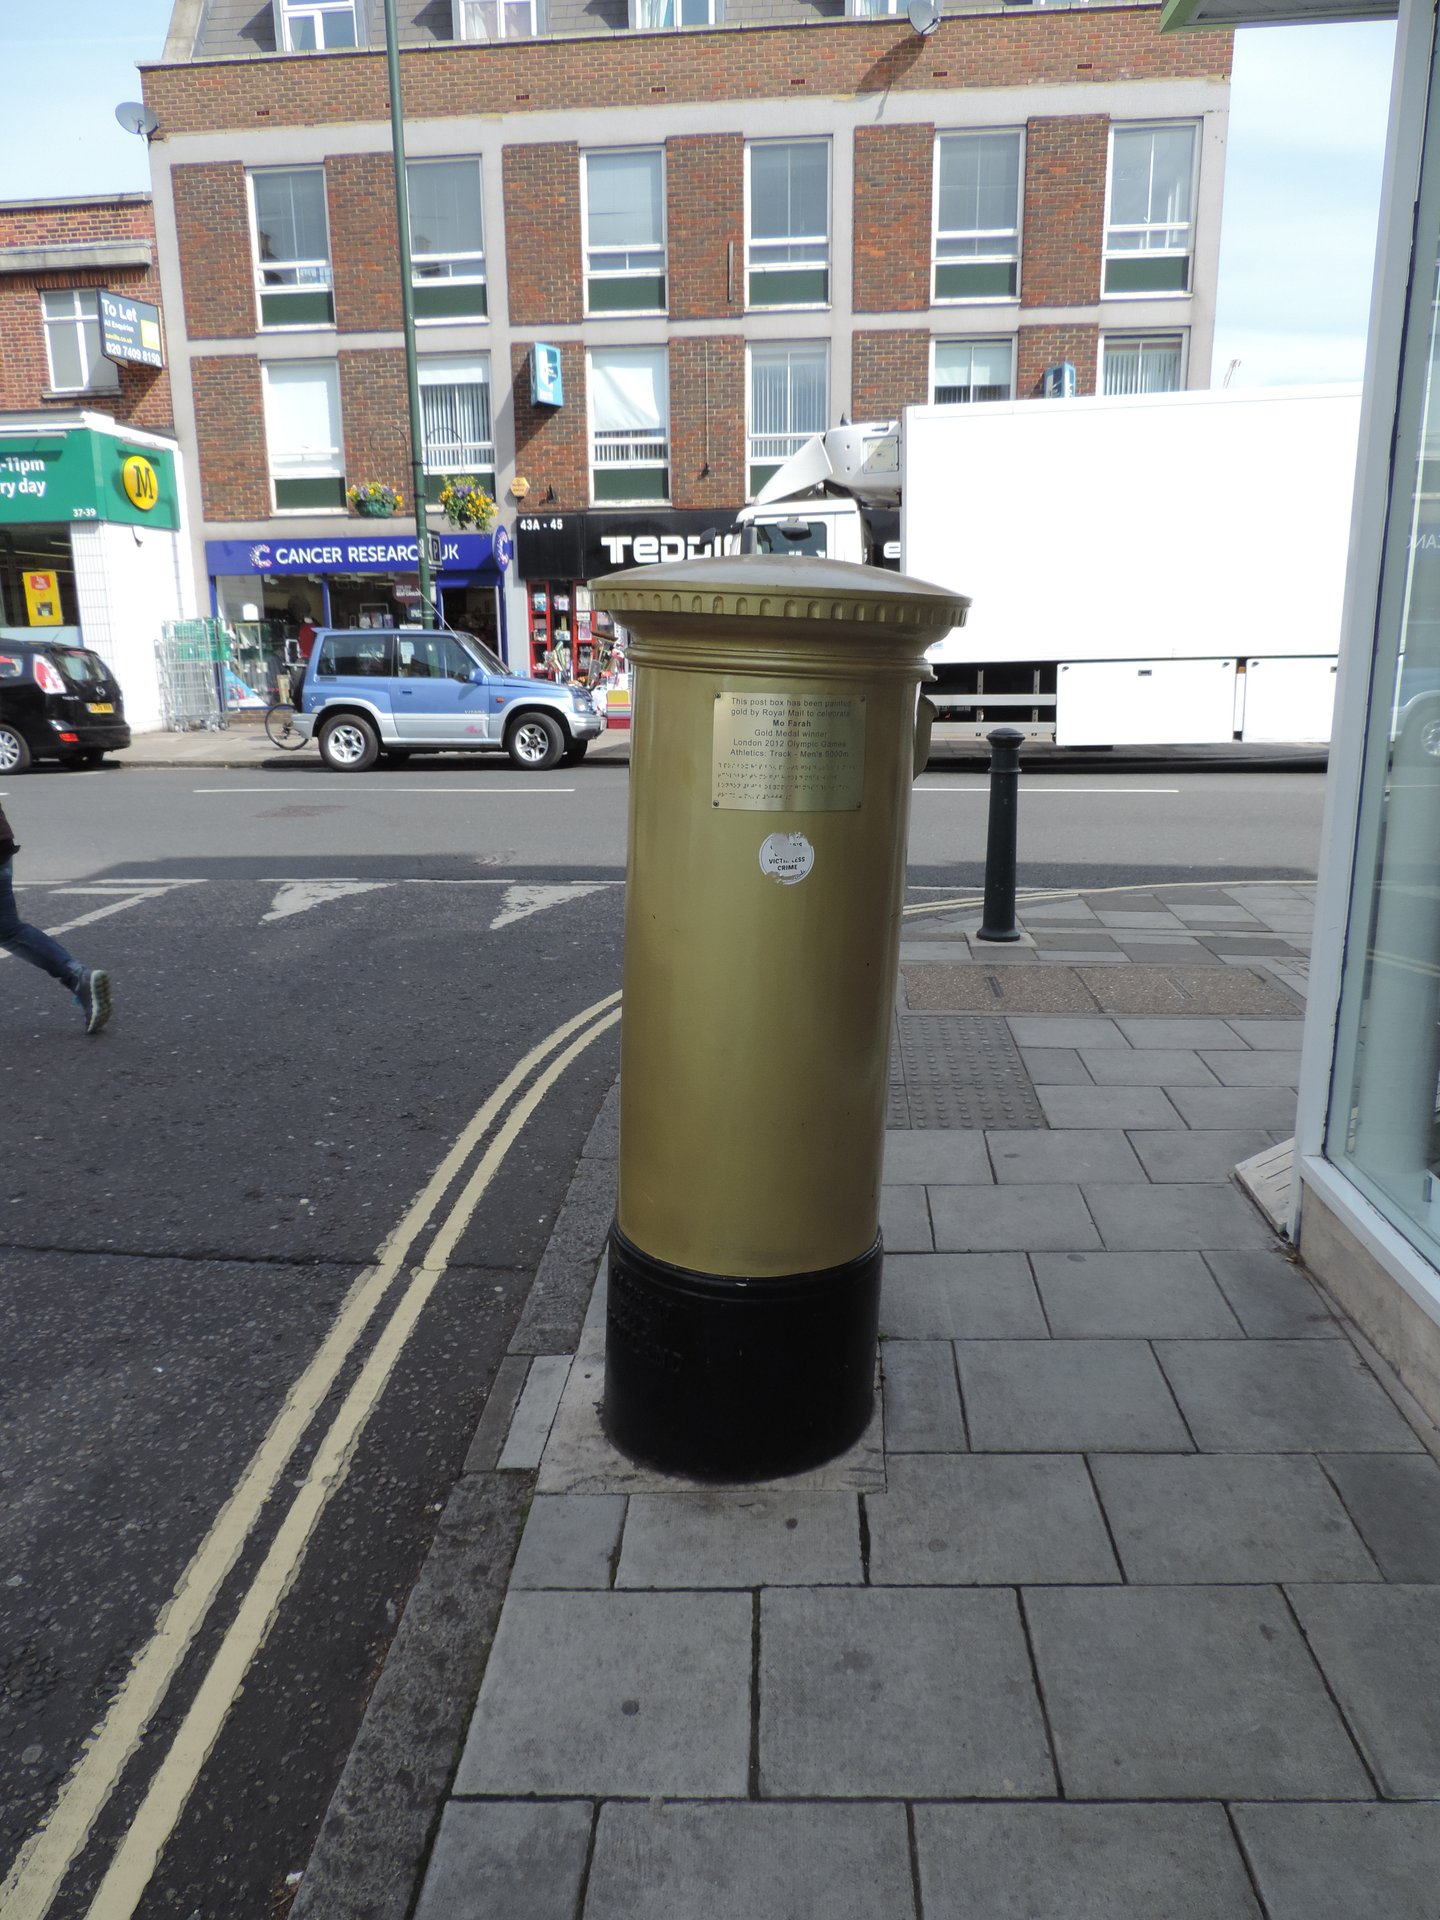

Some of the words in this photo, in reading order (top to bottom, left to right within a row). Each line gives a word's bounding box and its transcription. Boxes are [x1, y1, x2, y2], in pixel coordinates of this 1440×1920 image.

[101, 299, 116, 317] To
[119, 304, 137, 323] Let
[106, 342, 120, 355] 020
[122, 346, 141, 360] 7409
[0, 457, 45, 474] -11pm
[18, 478, 46, 497] day
[133, 465, 153, 499] M
[73, 508, 96, 517] 37-39
[520, 518, 540, 530] 43A
[550, 518, 563, 530] 45
[276, 547, 342, 565] CANCER
[348, 545, 418, 563] RESEARC
[731, 697, 747, 705] This
[750, 709, 760, 717] by
[762, 709, 785, 717] Royal
[788, 709, 804, 717] Mail
[772, 719, 785, 727] Mo
[733, 738, 762, 747] London
[787, 740, 819, 748] Olympic
[730, 748, 767, 757] Athletics:
[800, 750, 823, 758] Men's
